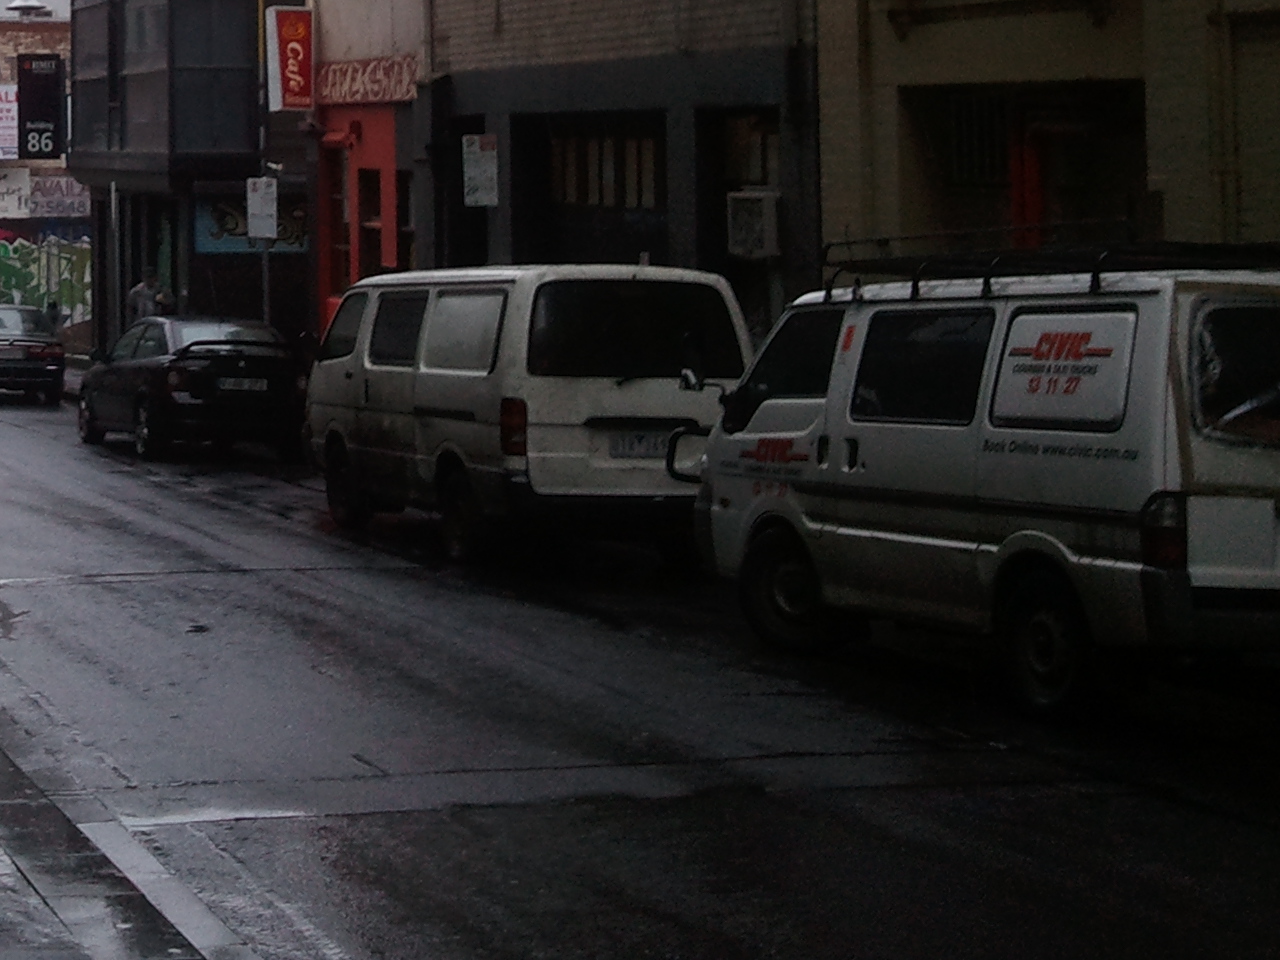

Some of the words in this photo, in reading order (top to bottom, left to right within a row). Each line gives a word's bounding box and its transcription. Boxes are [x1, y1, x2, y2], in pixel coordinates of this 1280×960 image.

[285, 41, 305, 92] Cafe
[27, 132, 54, 152] 86
[1032, 332, 1093, 360] CIVIC
